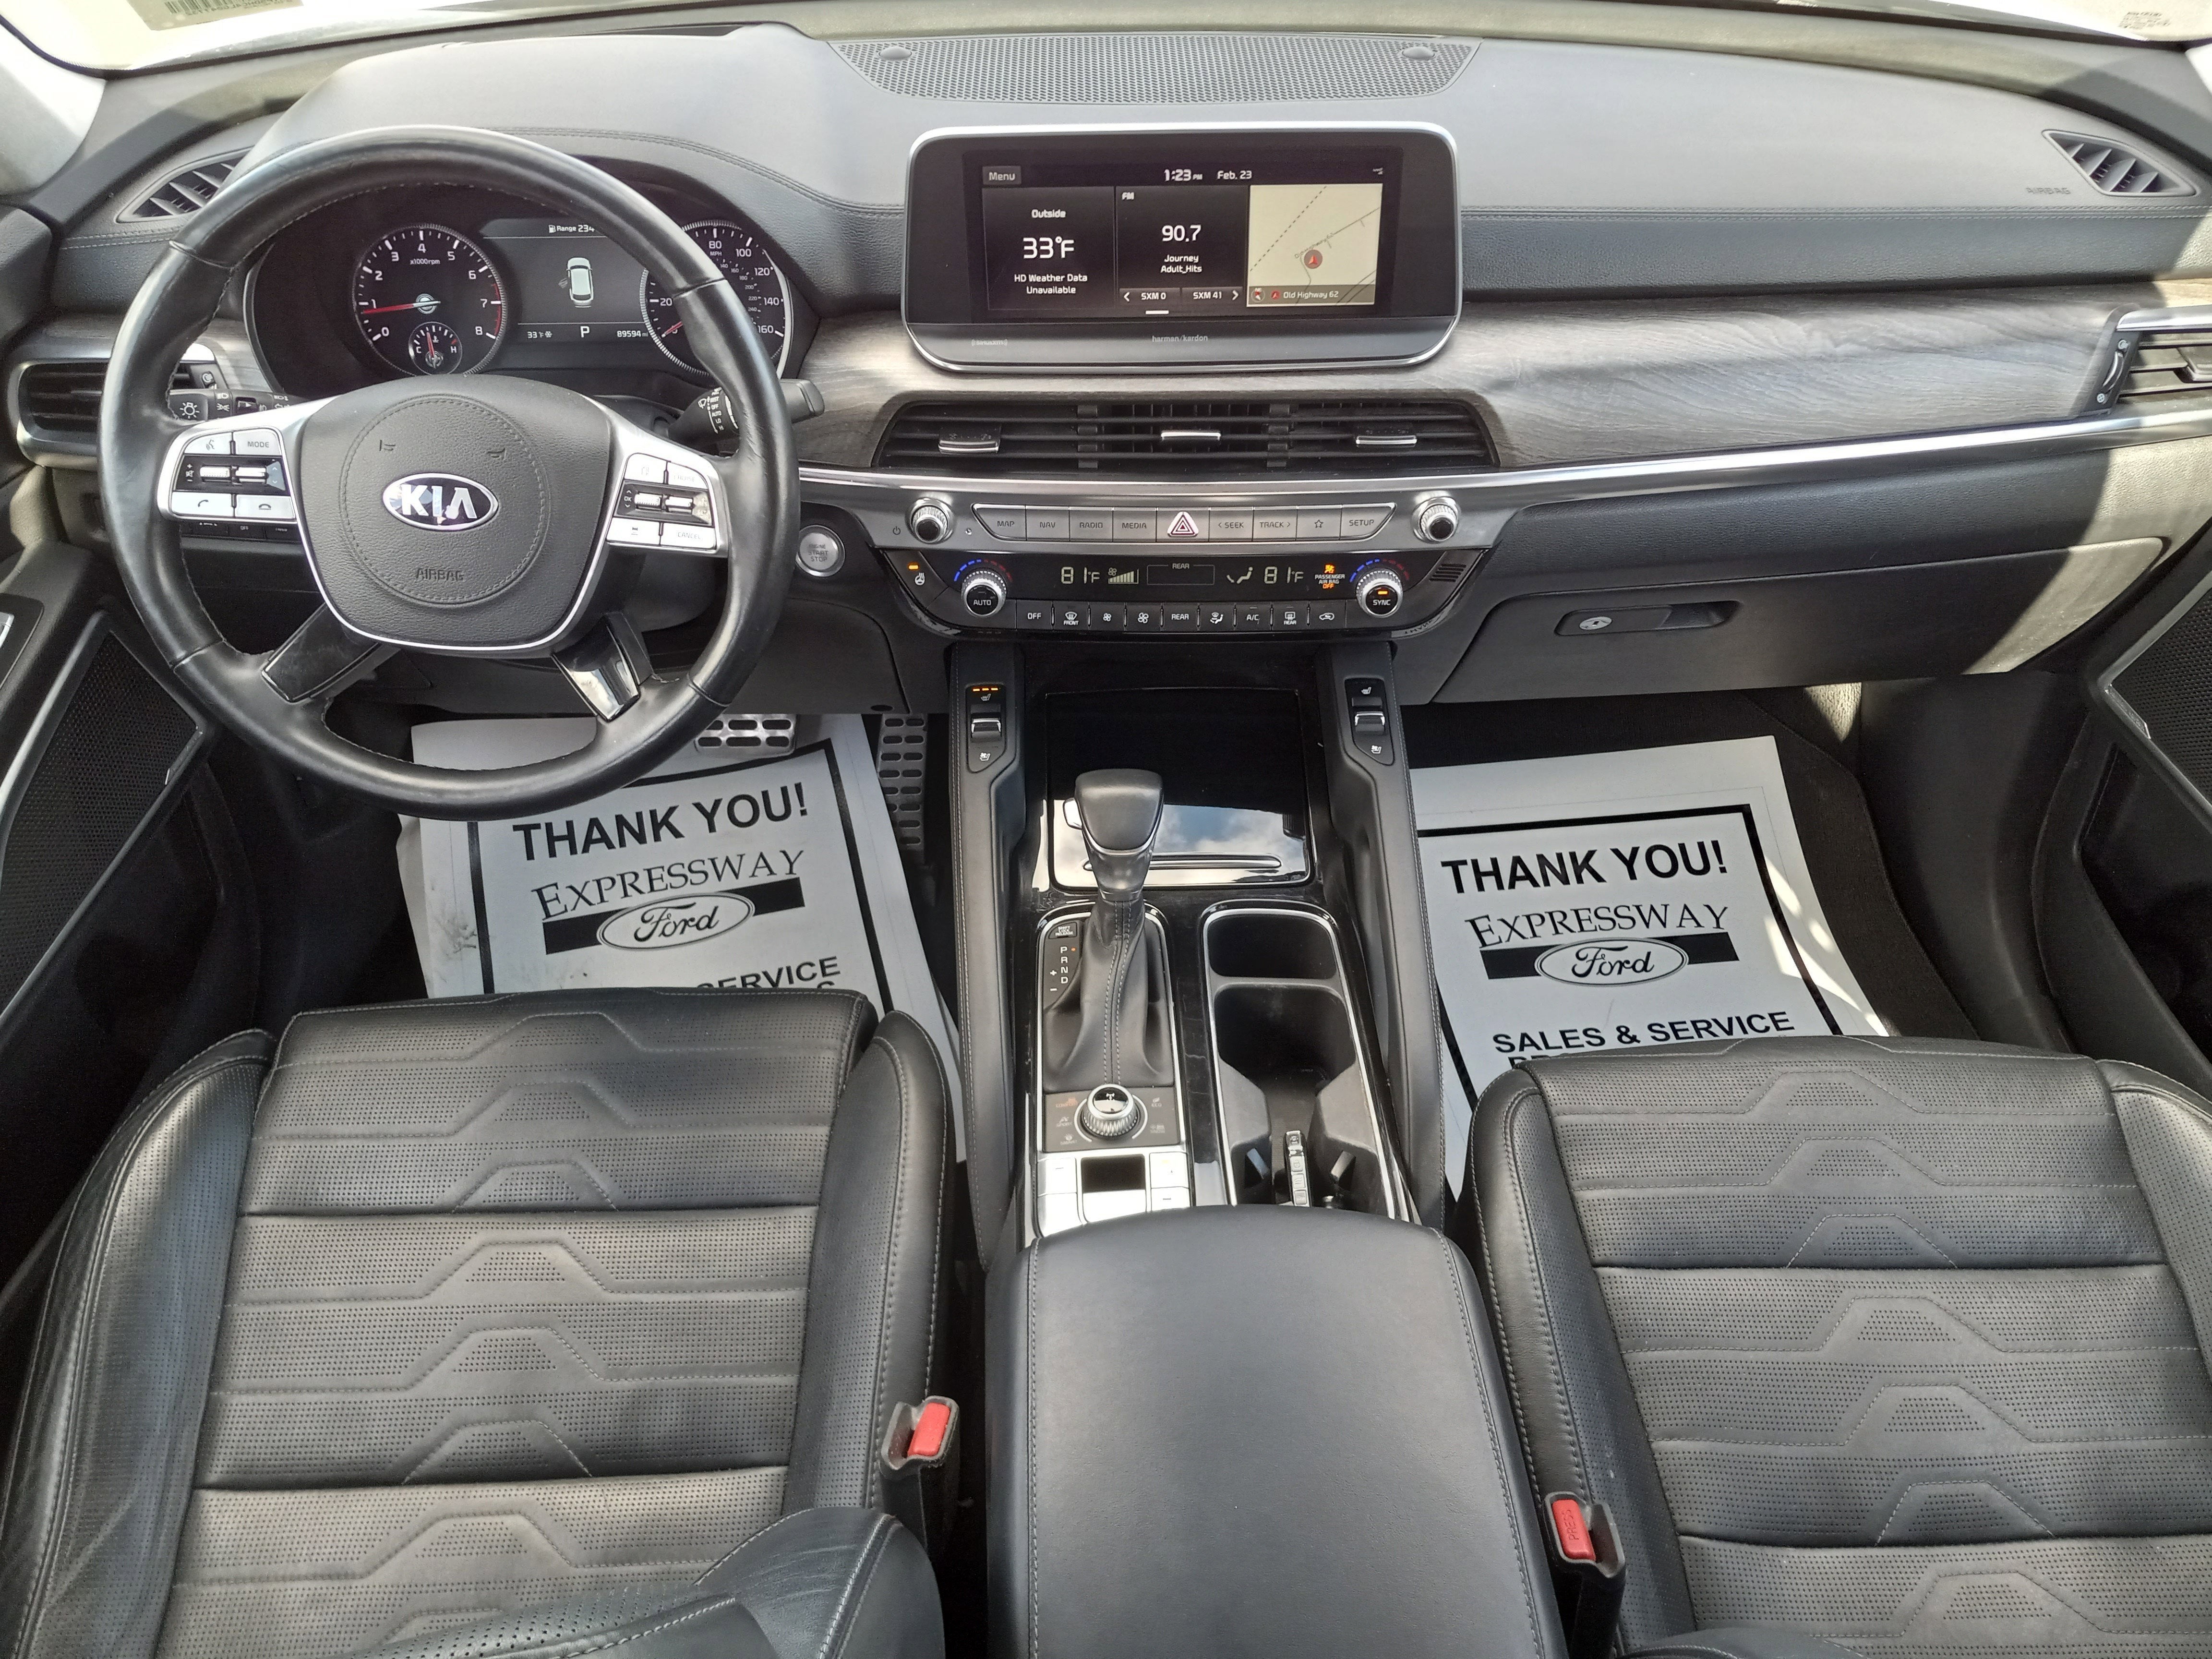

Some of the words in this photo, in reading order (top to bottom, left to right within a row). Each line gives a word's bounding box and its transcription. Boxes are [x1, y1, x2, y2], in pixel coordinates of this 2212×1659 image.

[989, 172, 1015, 180] Menu
[1164, 169, 1191, 181] 1:23
[1217, 170, 1238, 180] Feb.
[1240, 170, 1252, 180] 23
[1122, 192, 1134, 200] FM
[1032, 209, 1066, 218] Outside
[578, 224, 595, 232] 234
[1161, 225, 1202, 242] 90.7
[418, 243, 426, 253] 4
[709, 240, 722, 249] 80
[1023, 236, 1075, 259] 33°F
[391, 251, 399, 262] 3
[447, 251, 455, 261] 5
[736, 249, 752, 257] 100
[1164, 254, 1199, 263] Journey
[755, 267, 770, 276] 120
[1160, 265, 1202, 274] Adult_Hits
[375, 271, 383, 280] 2
[469, 270, 477, 280] 6
[1014, 274, 1027, 282] HD
[1029, 274, 1065, 282] Weather
[1067, 273, 1088, 282] Data
[1026, 286, 1076, 294] Unavailable
[1141, 292, 1159, 300] SXM
[1193, 291, 1211, 300] SXM
[371, 299, 377, 309] 1
[480, 299, 488, 308] 7
[660, 298, 673, 306] 20
[763, 297, 780, 306] 140
[381, 326, 389, 337] 0
[475, 326, 483, 336] 8
[580, 325, 590, 337] P
[757, 325, 774, 334] 160
[401, 483, 478, 520] KIA
[677, 531, 703, 540] CANCEL
[415, 568, 465, 581] AIRBAG
[512, 805, 685, 861] THANK
[692, 782, 808, 833] YOU!
[1441, 849, 1607, 894] THANK
[1610, 840, 1728, 880] YOU!
[531, 849, 805, 921] EXPRESSWAY
[634, 902, 720, 943] Ford
[1464, 903, 1729, 949] EXPRESSWAY
[1571, 945, 1656, 978] Ford
[697, 956, 841, 988] ERVICE
[1492, 1027, 1607, 1053] SALES
[1616, 1025, 1641, 1045] &
[1647, 1011, 1795, 1042] SERVICE
[1562, 1509, 1579, 1540] PRESS
